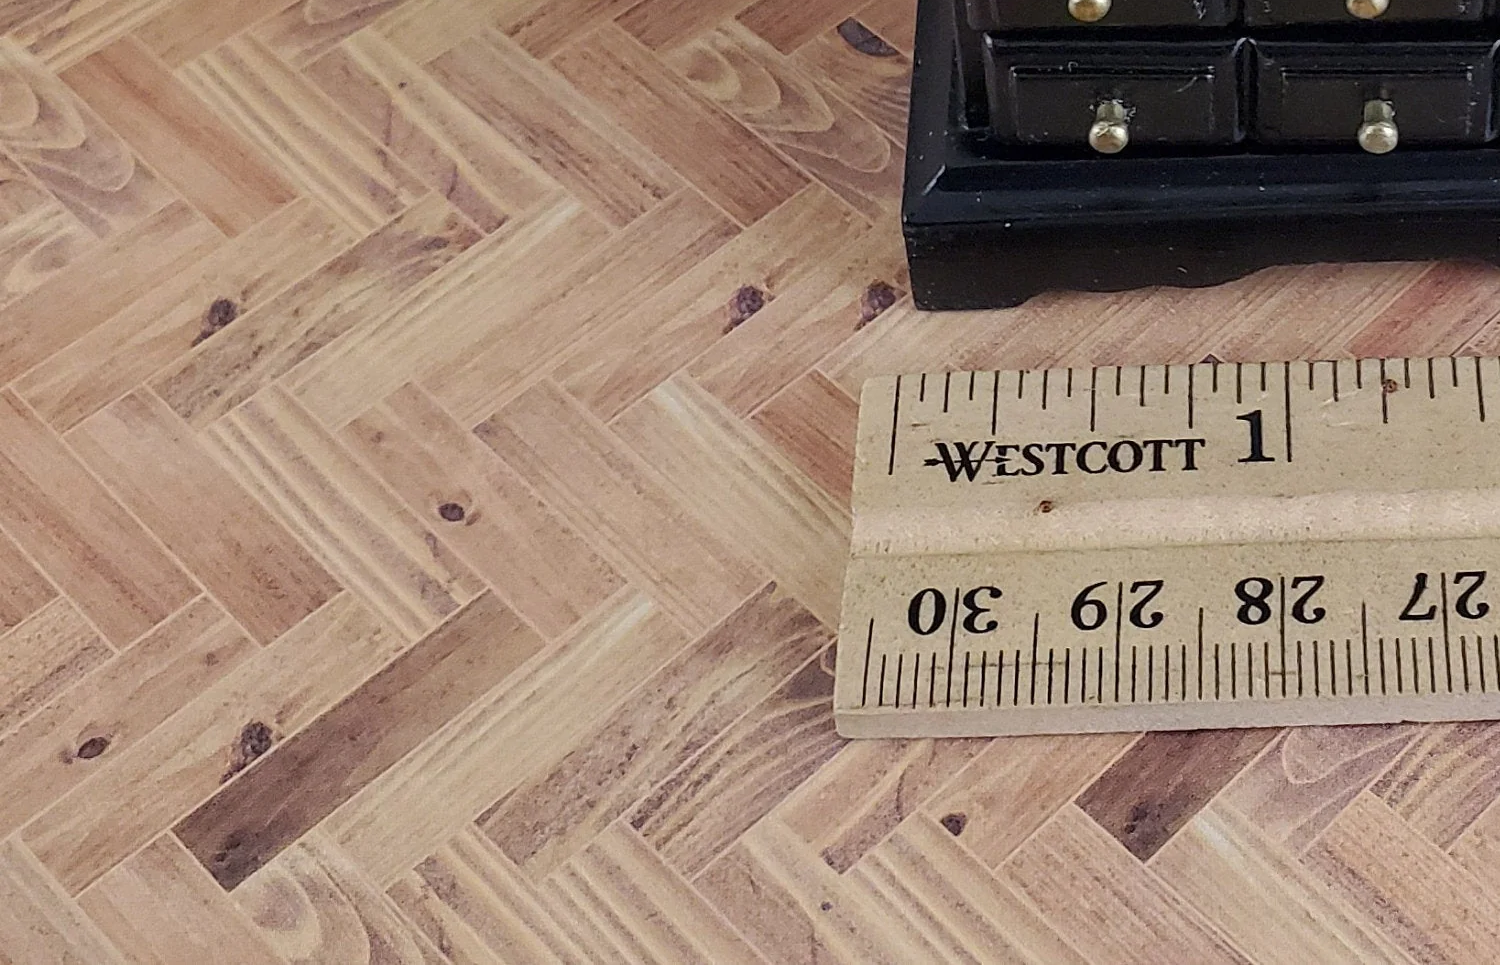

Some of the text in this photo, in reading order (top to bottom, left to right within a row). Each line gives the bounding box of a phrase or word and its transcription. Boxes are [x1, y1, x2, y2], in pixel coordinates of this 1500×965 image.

[934, 438, 1206, 483] WESTCOTT
[1236, 410, 1276, 464] 1
[907, 585, 1003, 635] 30
[1069, 579, 1165, 631] 29
[1235, 574, 1327, 625] 28
[1399, 570, 1491, 621] 27
